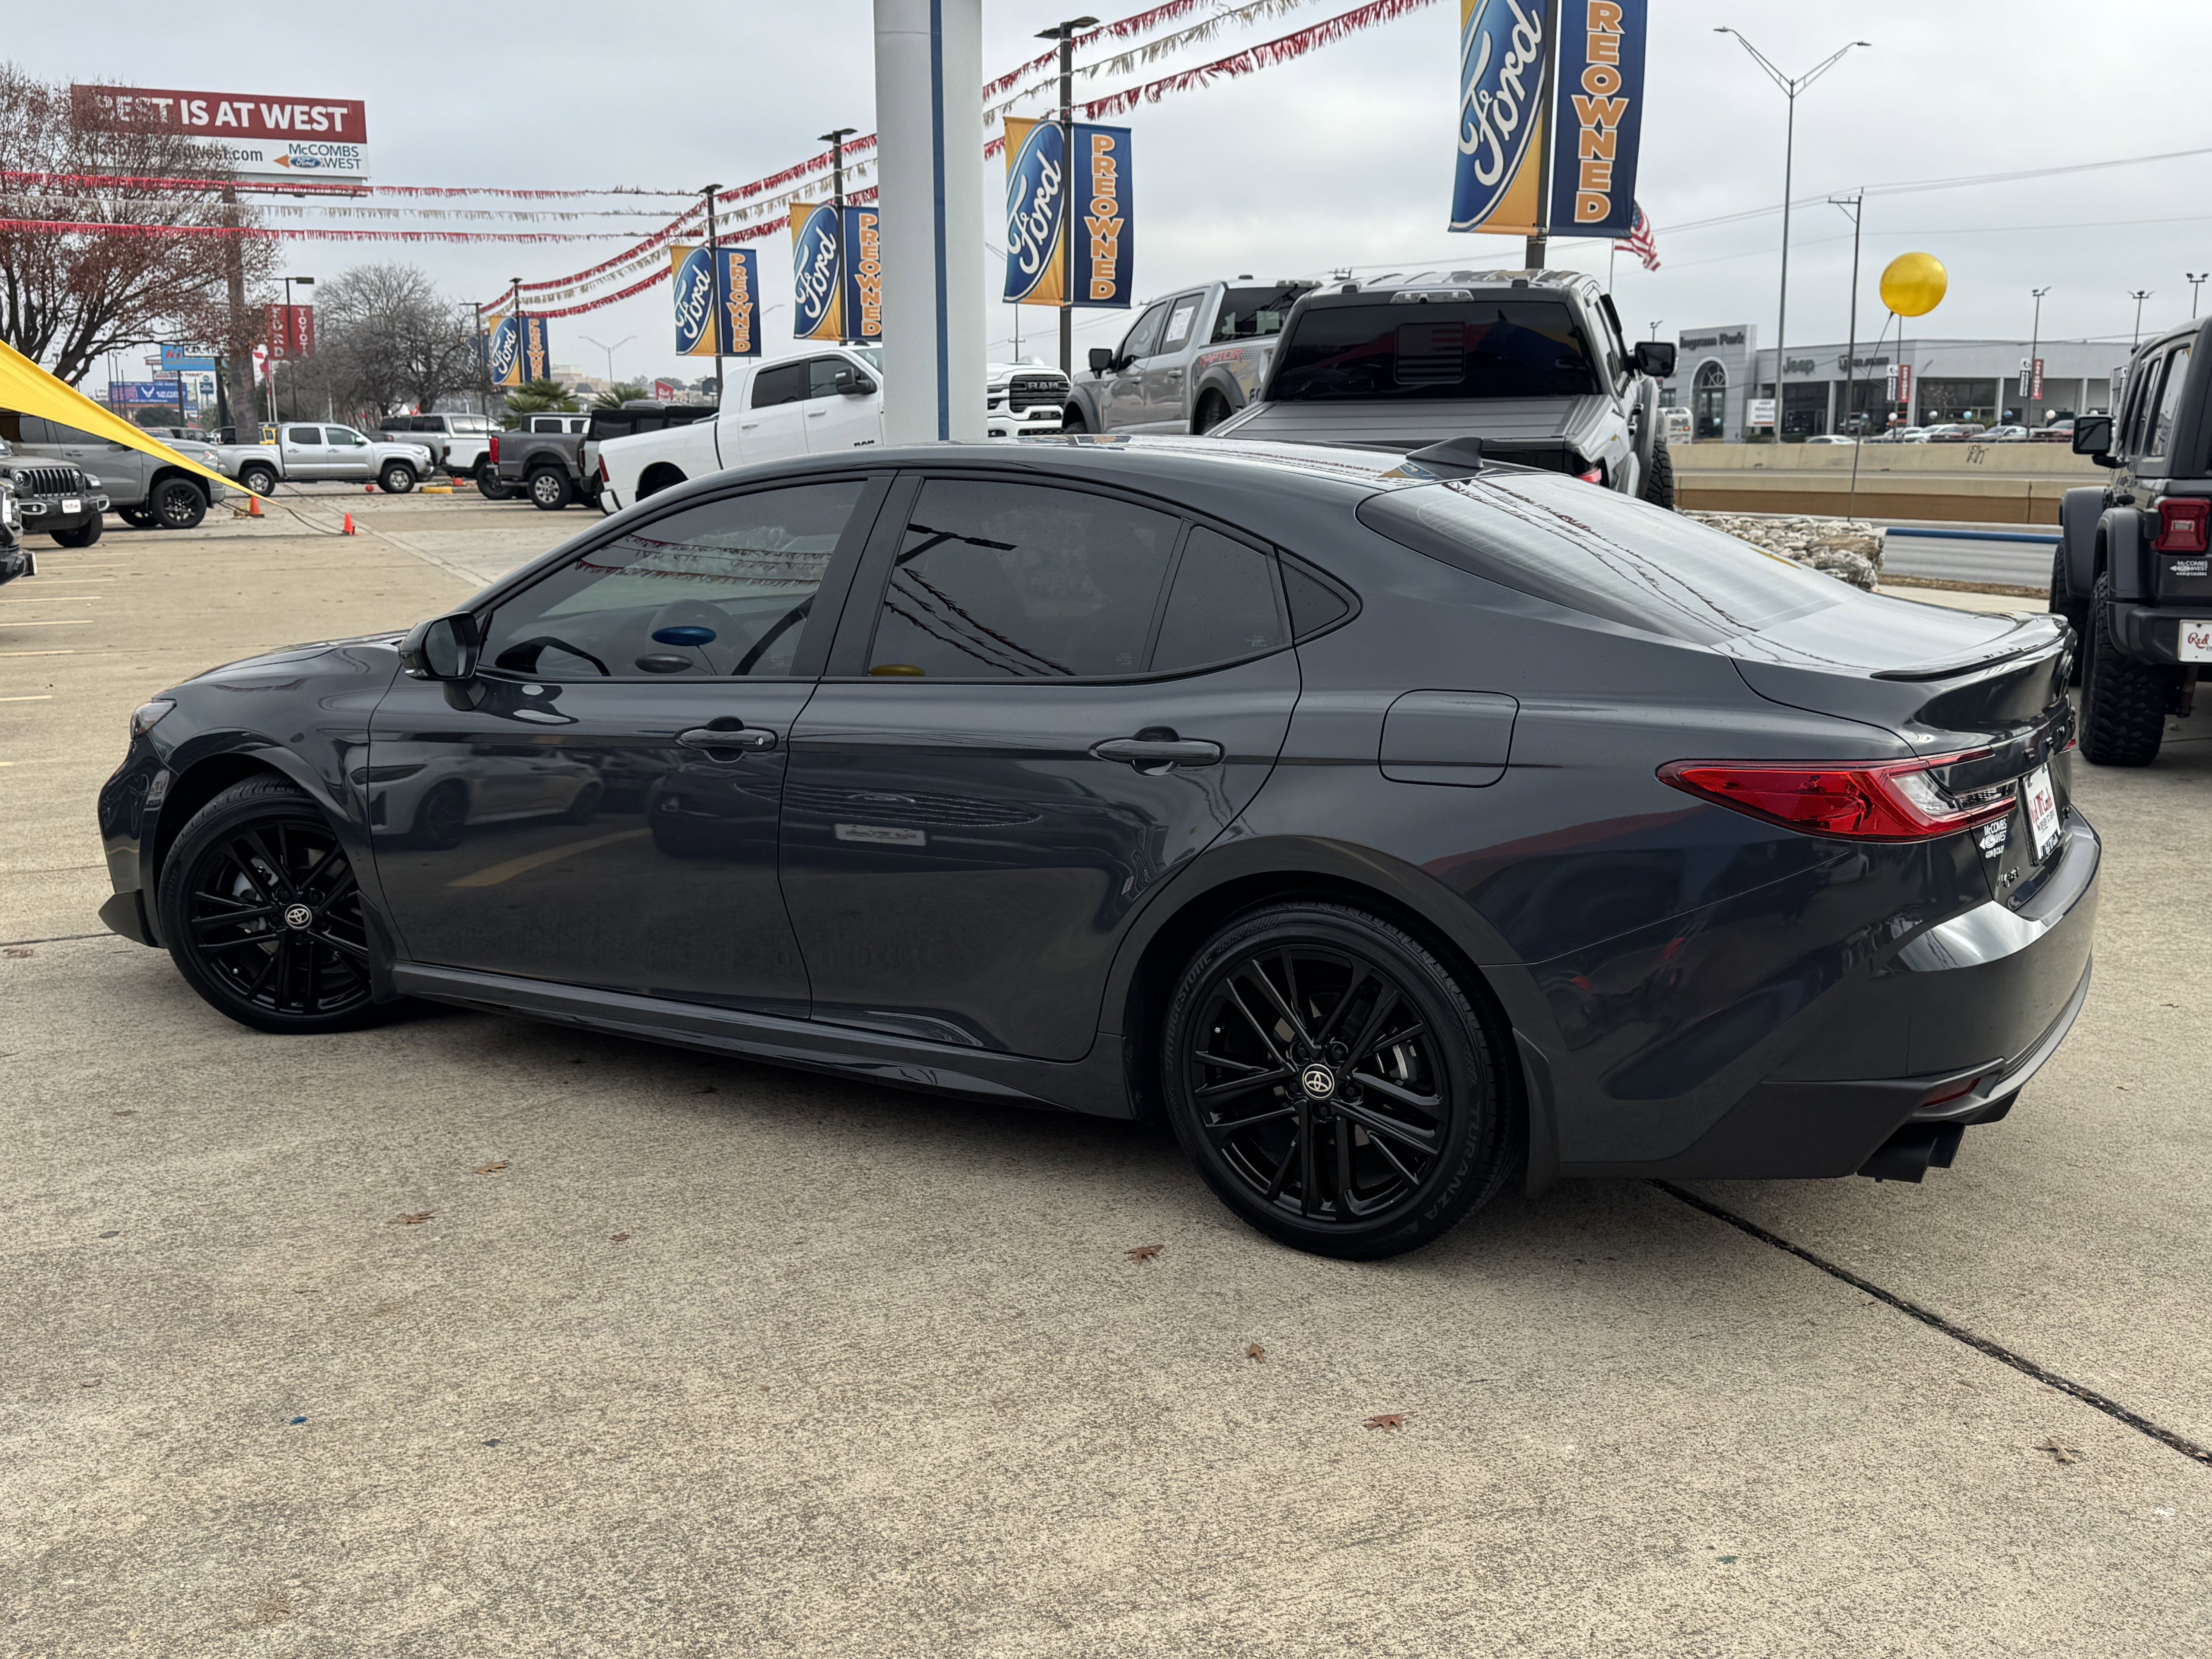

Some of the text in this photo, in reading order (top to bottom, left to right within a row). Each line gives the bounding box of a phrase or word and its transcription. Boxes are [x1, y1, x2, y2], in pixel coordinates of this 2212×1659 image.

[180, 99, 209, 126] IS
[215, 101, 255, 127] AT
[259, 103, 348, 132] WEST
[1459, 0, 1542, 186] Ford
[289, 144, 359, 157] McCOMBS
[295, 158, 361, 169] Ford WEST
[1008, 149, 1061, 274] Ford
[1084, 134, 1124, 300] PREOWNED
[795, 226, 837, 318] Ford
[854, 213, 882, 336] PREOWNED
[675, 264, 711, 339] Ford
[725, 253, 754, 352] PREOWNED
[297, 307, 309, 359] TOYOTA
[492, 327, 517, 374] Ford
[1200, 347, 1243, 368] RAPTOR
[1680, 332, 1745, 351] Ingram Park
[1027, 381, 1059, 390] RAM
[1783, 356, 1815, 375] Jeep
[2188, 632, 2210, 649] Red
[1424, 1101, 1481, 1221] TURANZA
